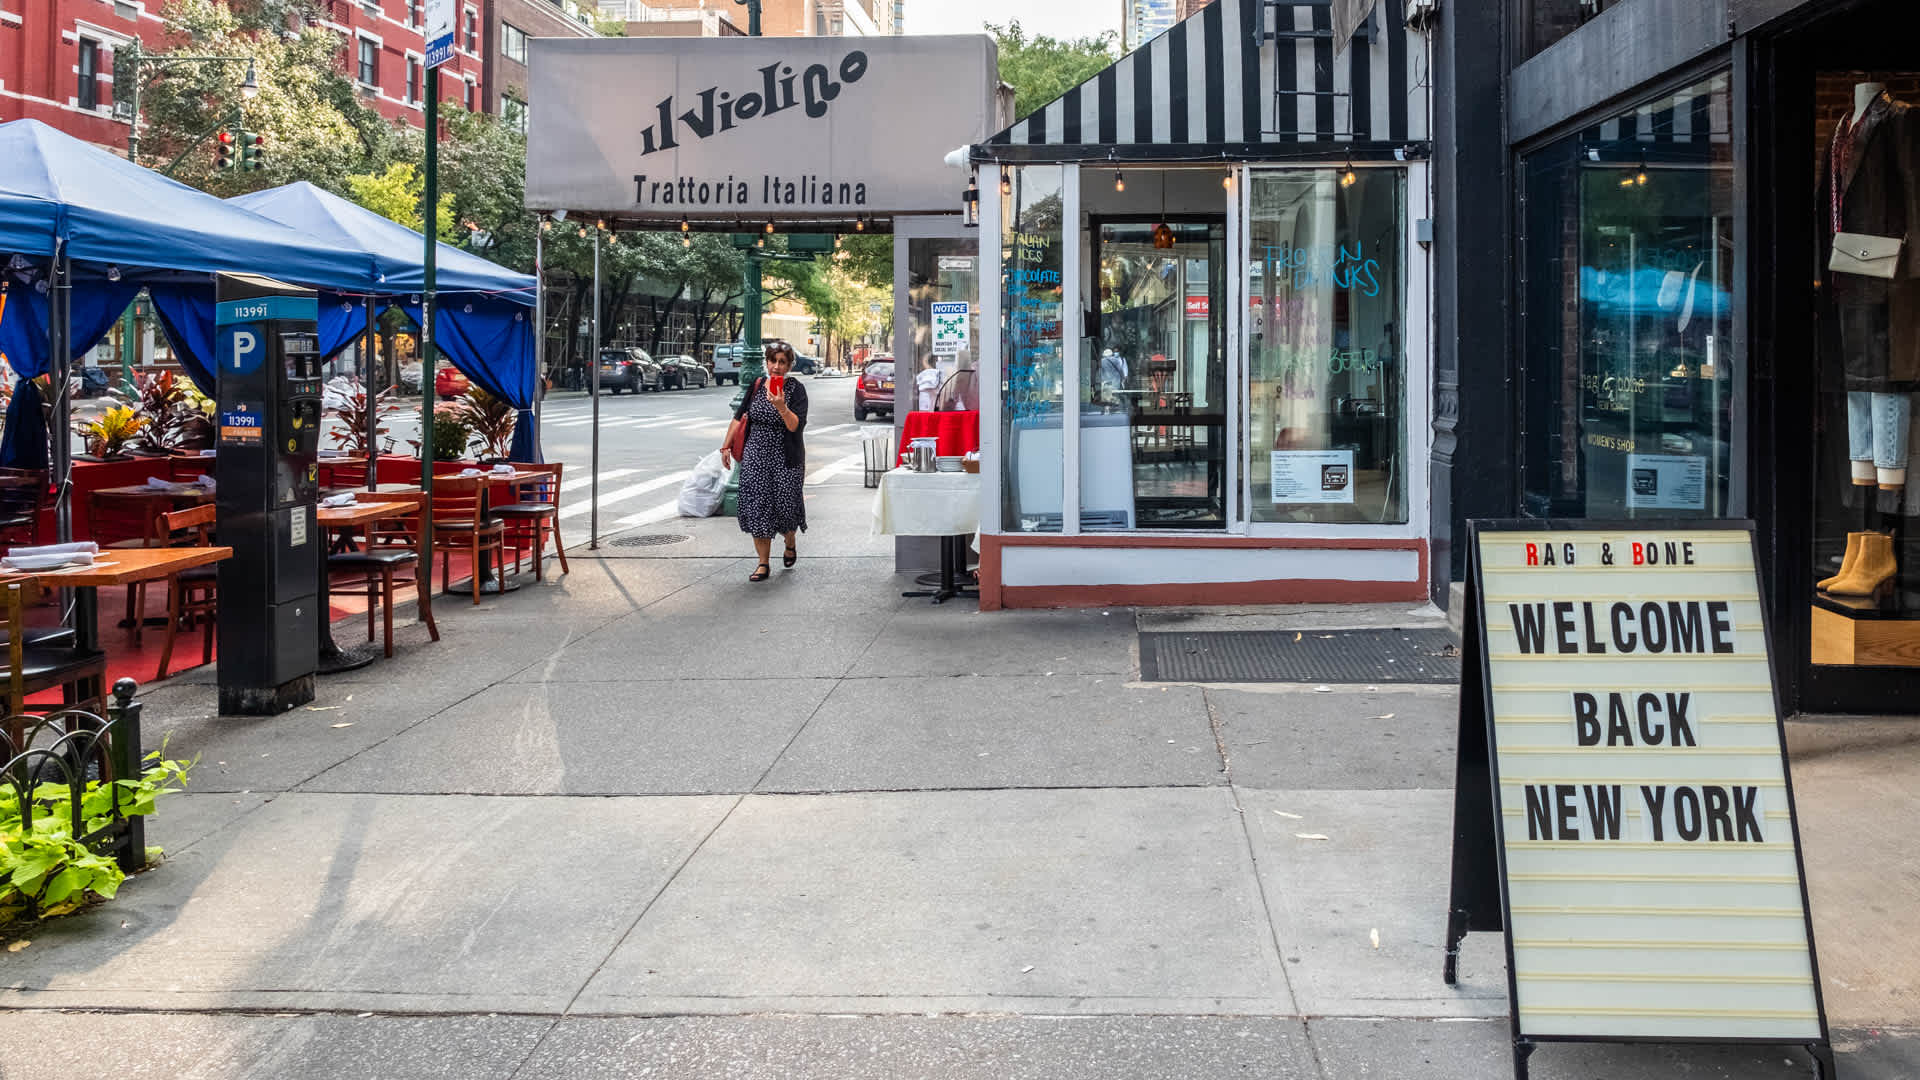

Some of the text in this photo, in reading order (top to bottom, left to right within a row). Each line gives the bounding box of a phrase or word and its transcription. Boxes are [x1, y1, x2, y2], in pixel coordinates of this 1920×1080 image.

[634, 174, 866, 204] Trattoria Italiana
[234, 306, 267, 318] 113991
[934, 305, 966, 313] NOTICE
[233, 331, 256, 368] P
[228, 416, 255, 427] 113991
[1616, 438, 1635, 453] SHOP
[1526, 542, 1694, 566] RAG & BONE
[1509, 601, 1734, 654] WELCOME
[1573, 692, 1697, 747] BACK
[1524, 784, 1764, 843] NEW YORK
